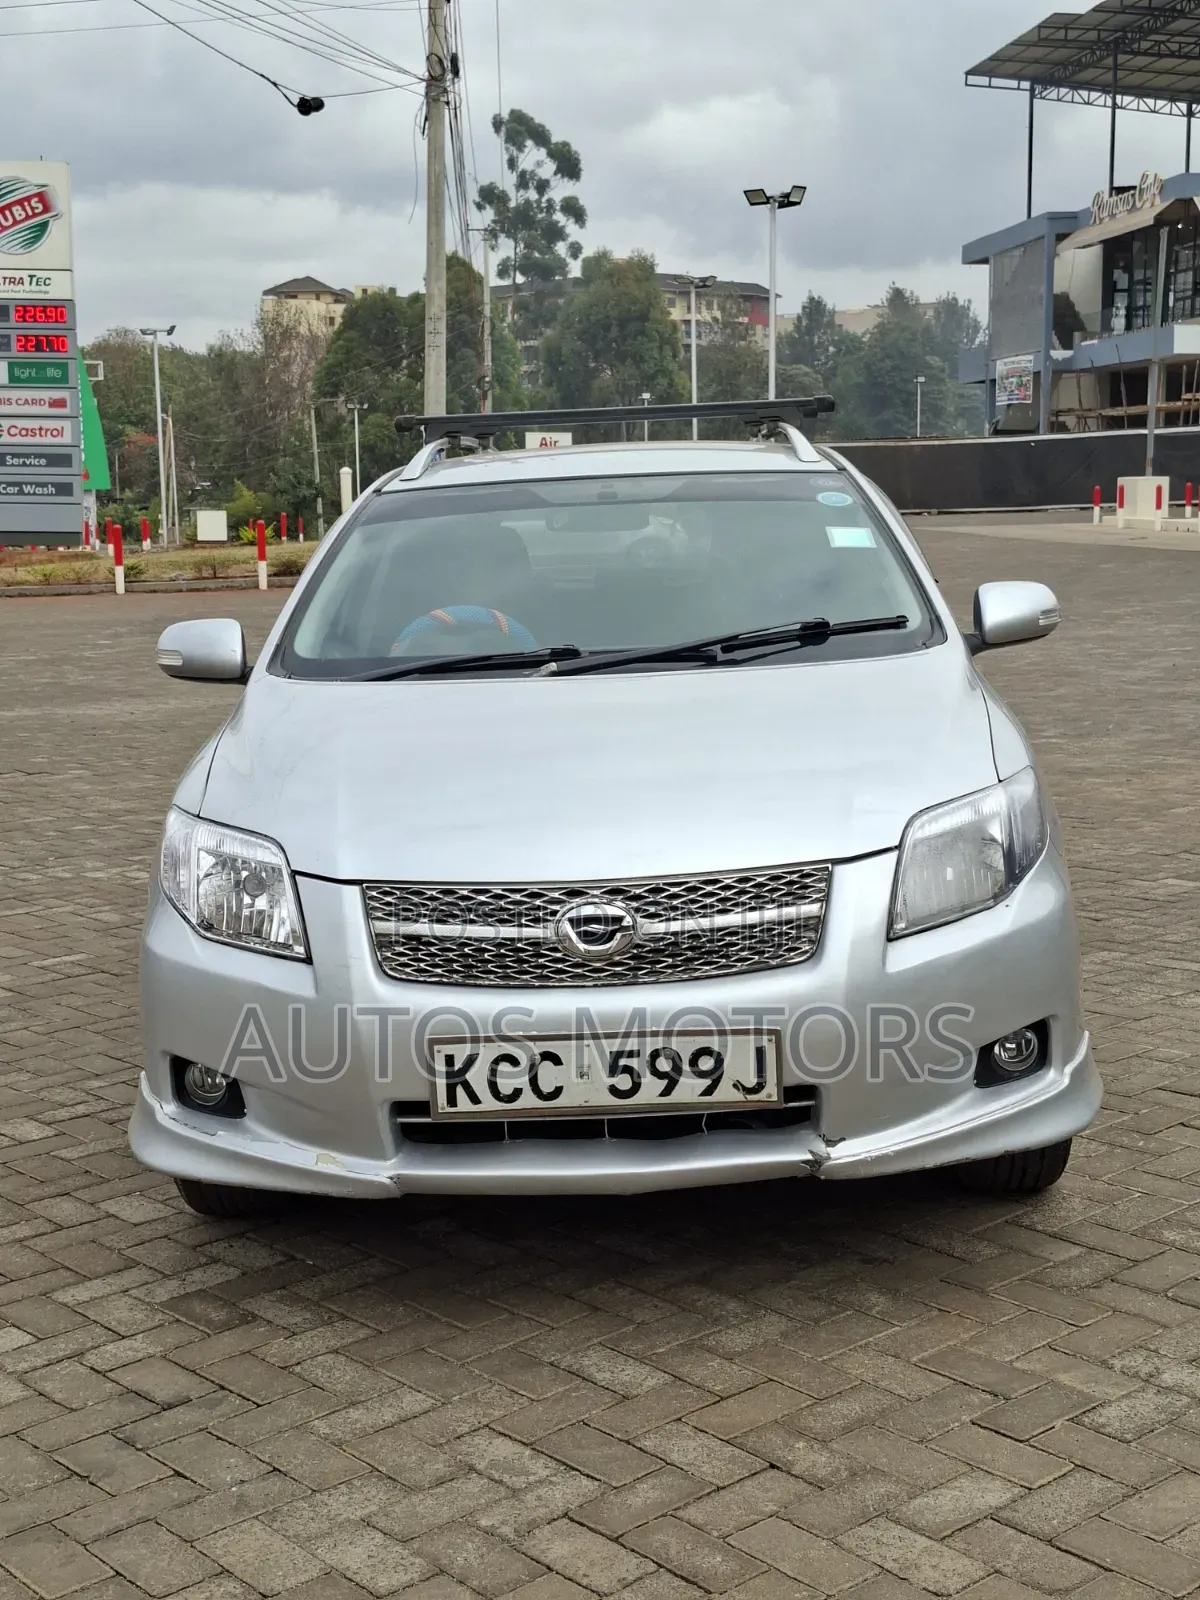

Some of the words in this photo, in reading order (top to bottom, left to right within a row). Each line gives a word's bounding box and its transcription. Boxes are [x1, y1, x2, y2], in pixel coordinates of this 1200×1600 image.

[15, 306, 67, 323] 226.90
[16, 336, 68, 352] 227.70
[14, 367, 37, 379] light
[46, 367, 62, 378] life
[15, 397, 46, 407] CARD
[7, 425, 65, 438] Castrol
[539, 436, 559, 448] Air
[5, 455, 47, 465] Service
[0, 485, 19, 494] Car
[22, 484, 56, 494] Wash
[444, 1050, 565, 1108] KCC
[607, 1046, 767, 1100] 599J
